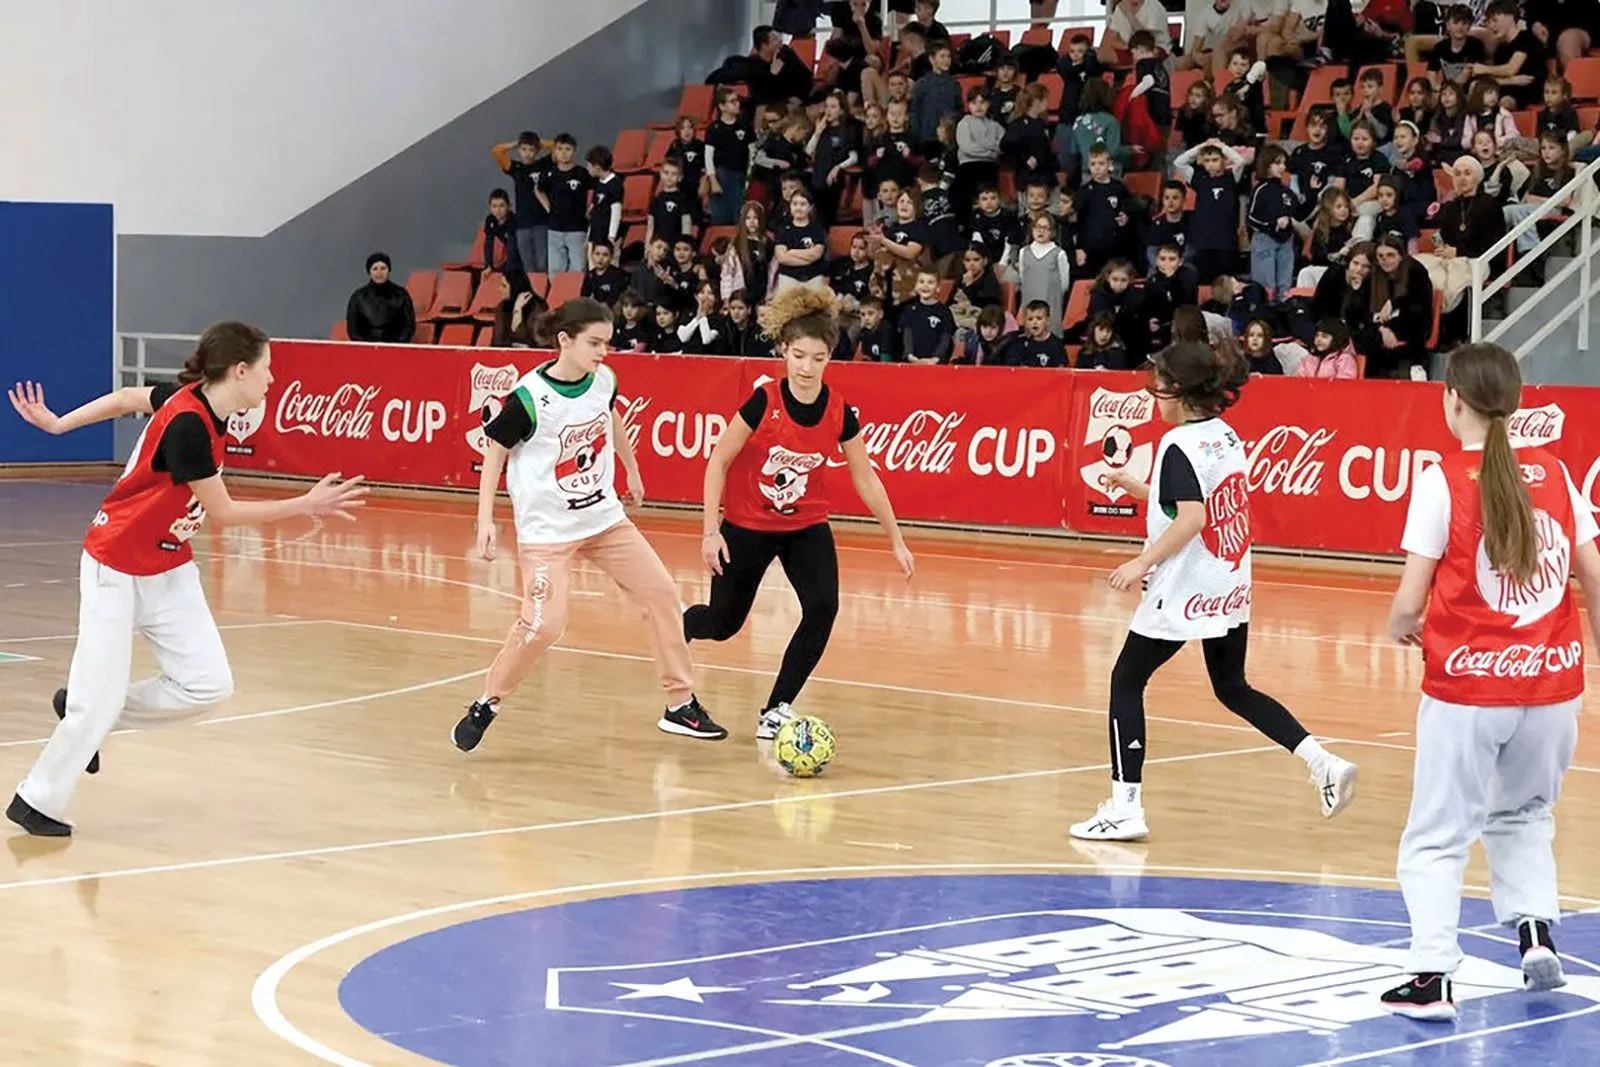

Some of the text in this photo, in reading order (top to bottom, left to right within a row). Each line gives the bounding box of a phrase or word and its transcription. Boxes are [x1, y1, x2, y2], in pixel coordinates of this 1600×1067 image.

[230, 422, 250, 432] CUP
[275, 380, 447, 443] Coca-Cola CUP
[1092, 393, 1150, 420] Coca-Cola
[651, 411, 728, 459] CUP
[967, 426, 1055, 478] CUP
[1445, 640, 1581, 678] Coca-Cola CUP
